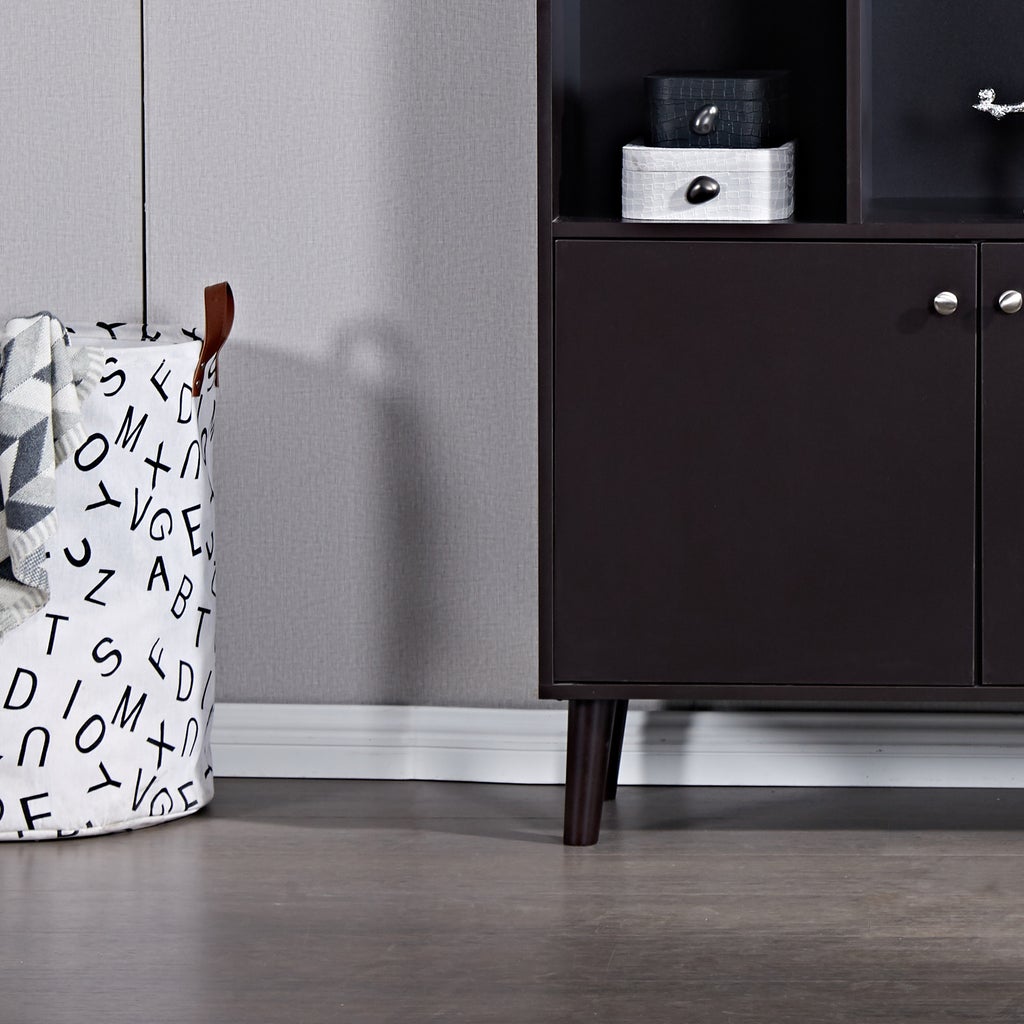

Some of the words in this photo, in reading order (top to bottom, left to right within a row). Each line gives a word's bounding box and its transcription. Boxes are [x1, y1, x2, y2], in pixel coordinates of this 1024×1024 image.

[100, 357, 126, 397] S
[115, 405, 148, 453] M
[74, 433, 109, 472] O
[144, 441, 171, 490] X
[85, 480, 122, 511] Y
[130, 488, 152, 531] V
[150, 508, 173, 541] G
[182, 504, 202, 556] E
[84, 568, 115, 606] Z
[147, 556, 170, 591] A
[171, 574, 193, 619] B
[45, 613, 69, 655] T
[92, 637, 122, 677] S
[3, 667, 38, 710] D
[176, 660, 194, 702] D
[111, 685, 148, 732] M
[75, 714, 106, 753] O
[147, 720, 176, 770] X
[87, 761, 122, 793] Y
[132, 768, 156, 811] V
